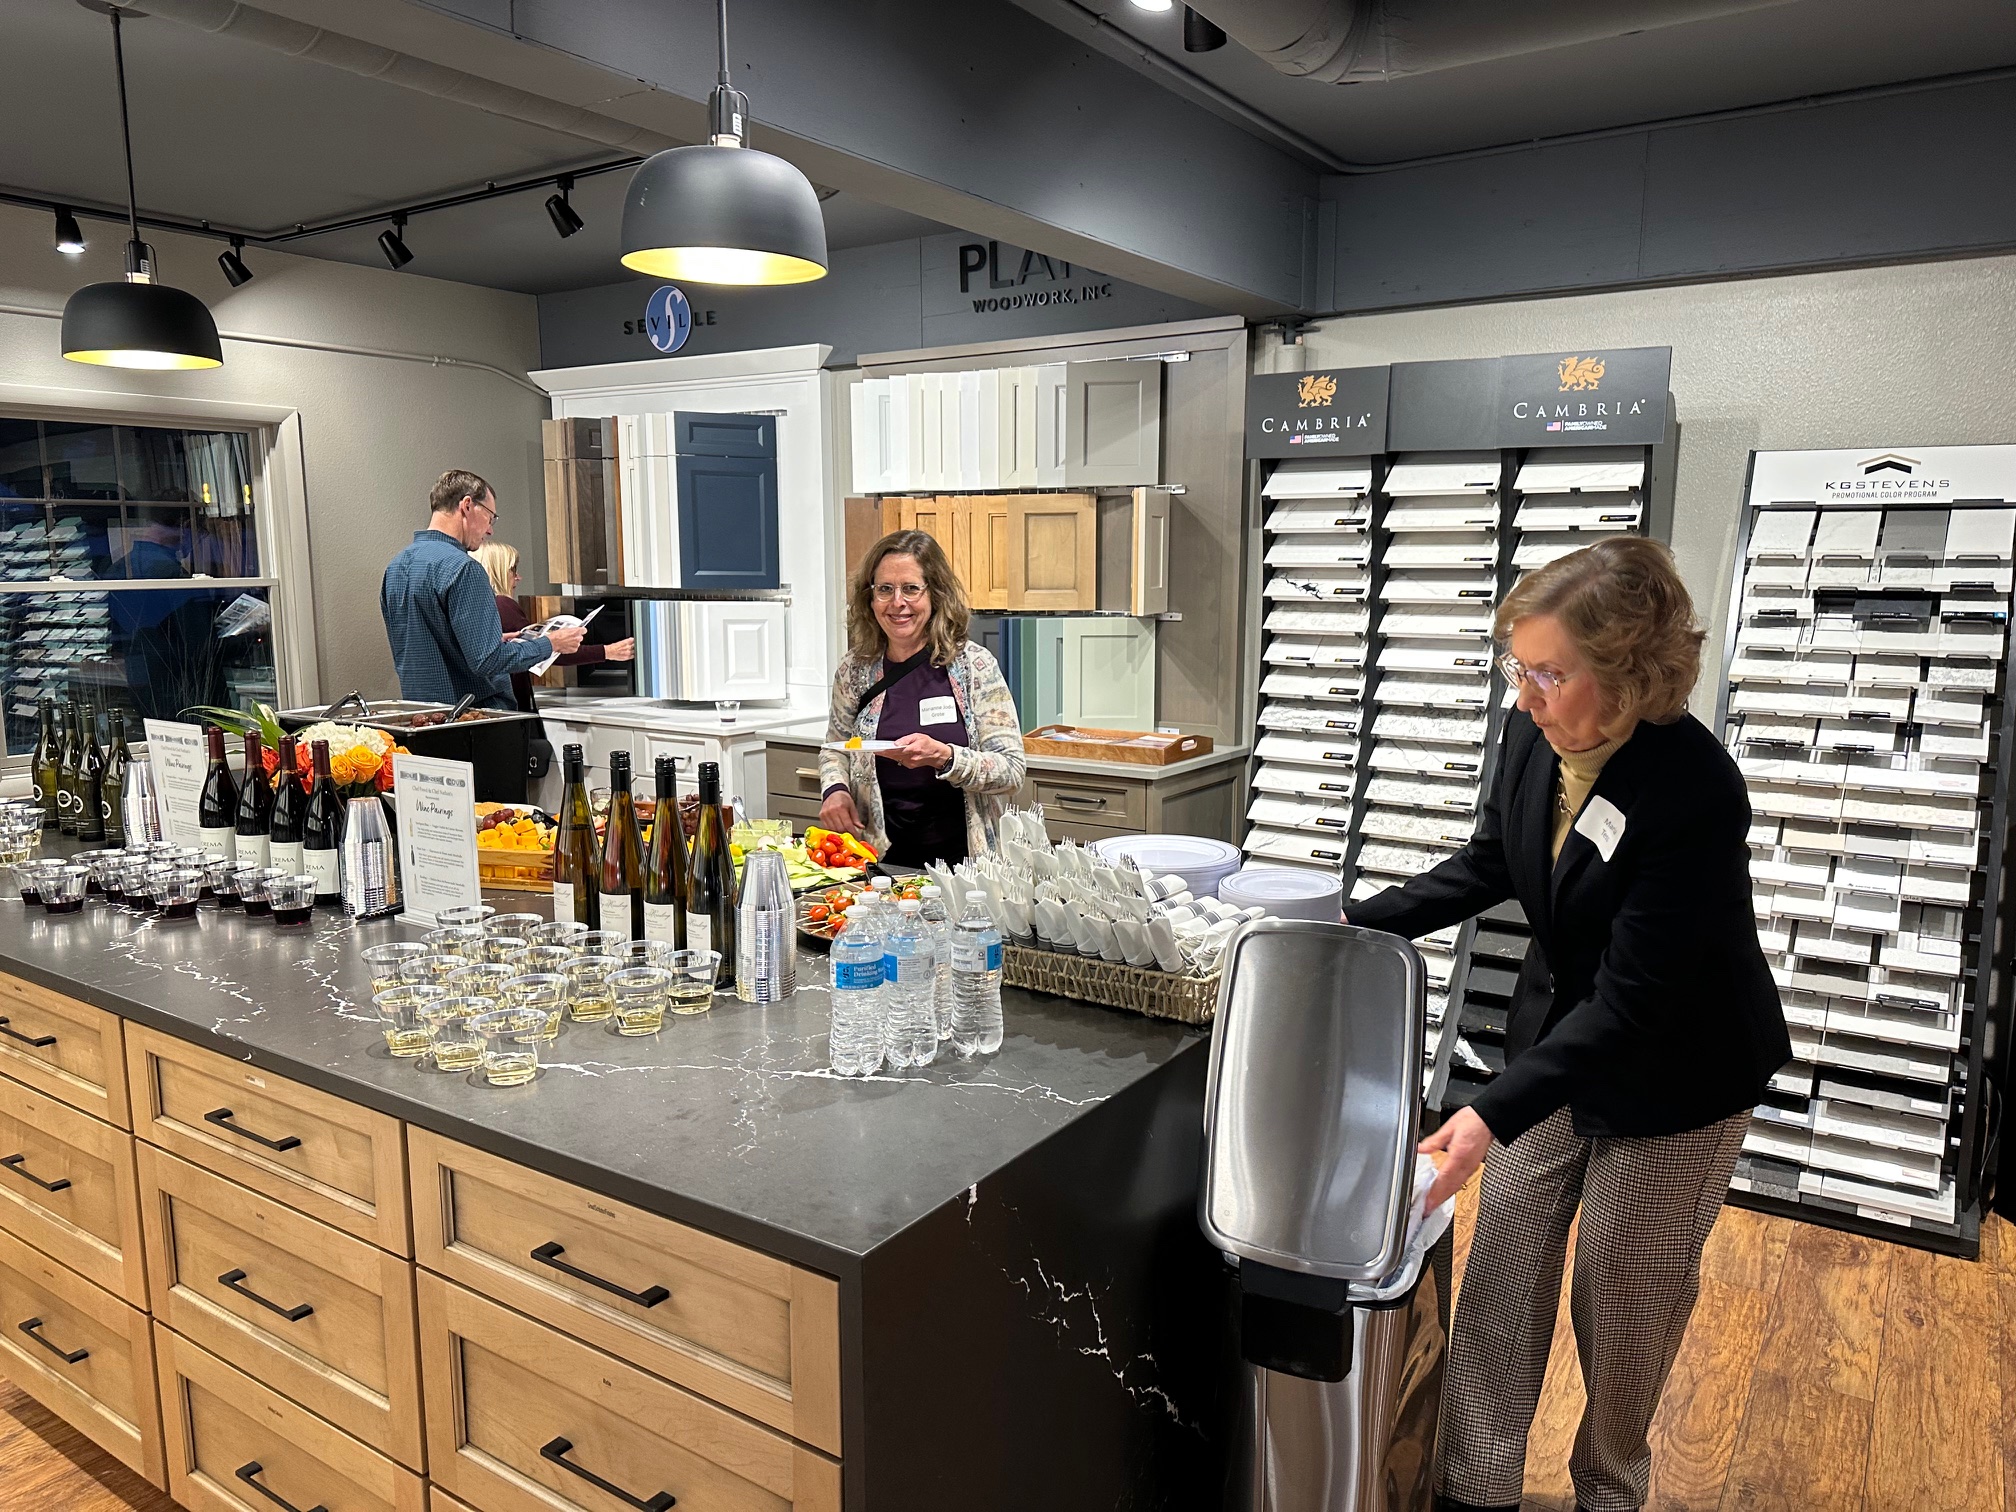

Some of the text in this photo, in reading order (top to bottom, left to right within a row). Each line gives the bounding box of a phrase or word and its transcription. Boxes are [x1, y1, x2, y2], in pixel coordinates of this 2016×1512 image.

[959, 241, 1107, 293] PLA
[623, 311, 718, 335] SEVILLE
[1832, 491, 1879, 499] PROMOTIONAL
[1904, 490, 1937, 498] PROGRAM
